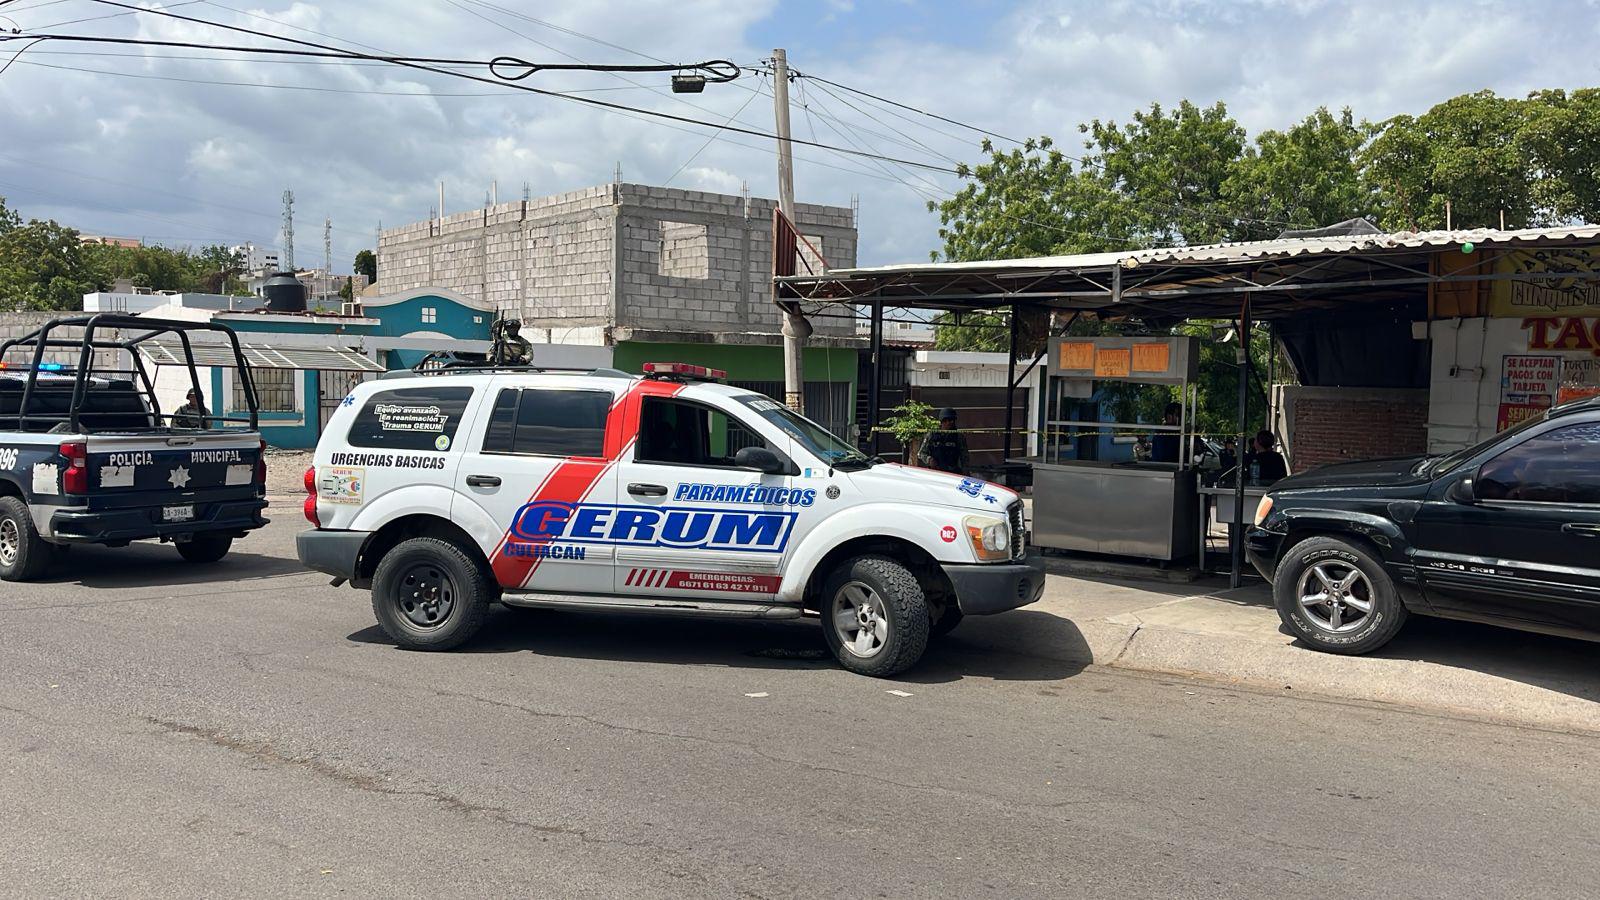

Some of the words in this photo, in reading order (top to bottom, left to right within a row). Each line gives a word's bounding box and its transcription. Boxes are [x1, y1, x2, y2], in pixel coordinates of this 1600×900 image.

[1520, 317, 1600, 356] TA
[1508, 359, 1518, 367] SE
[1519, 359, 1554, 368] ACEPTAN
[1508, 371, 1534, 380] PAGOS
[1536, 371, 1553, 380] CON
[1513, 383, 1546, 391] TARJETA
[191, 450, 242, 463] MUNICIPAL
[331, 453, 393, 467] URGENCIAS
[395, 455, 446, 470] BASICAS
[674, 483, 817, 507] PARAMÉDICOS
[504, 542, 586, 561] CULIACÁN
[1302, 549, 1359, 564] COOPER
[689, 572, 756, 583] EMERGENCIAS:
[716, 582, 728, 590] 63
[730, 583, 743, 591] 42
